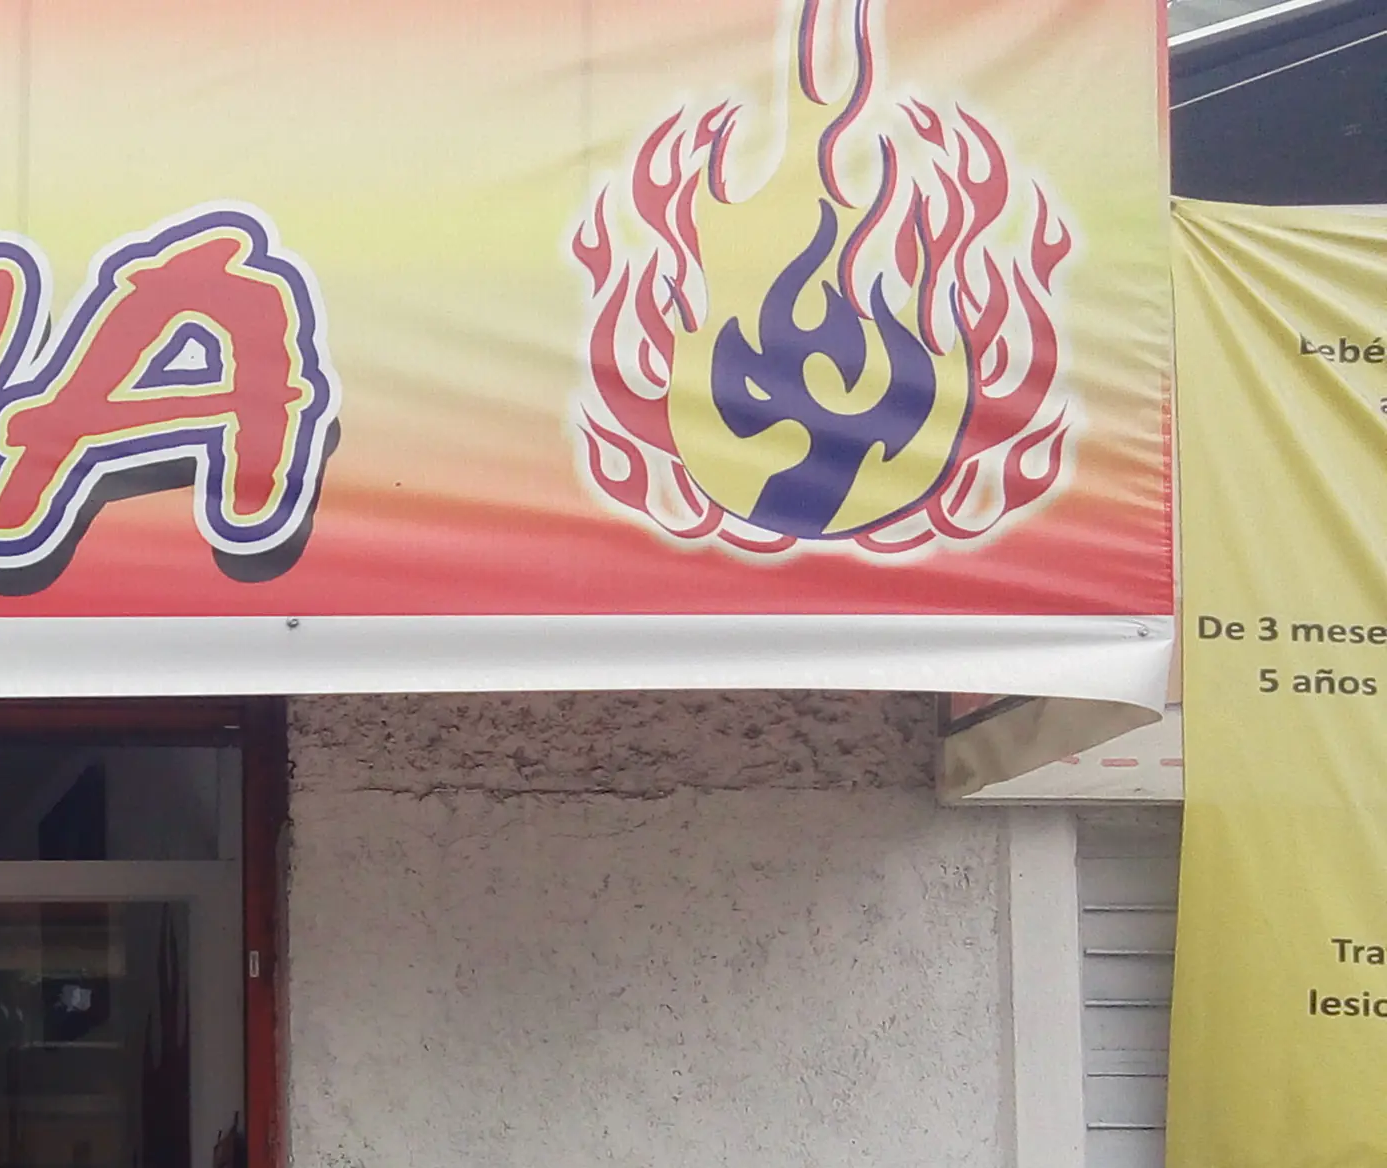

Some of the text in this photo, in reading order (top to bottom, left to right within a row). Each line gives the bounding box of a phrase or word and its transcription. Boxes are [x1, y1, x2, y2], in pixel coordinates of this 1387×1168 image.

[1198, 616, 1387, 644] De 3 mese
[1259, 668, 1377, 695] 5 años
